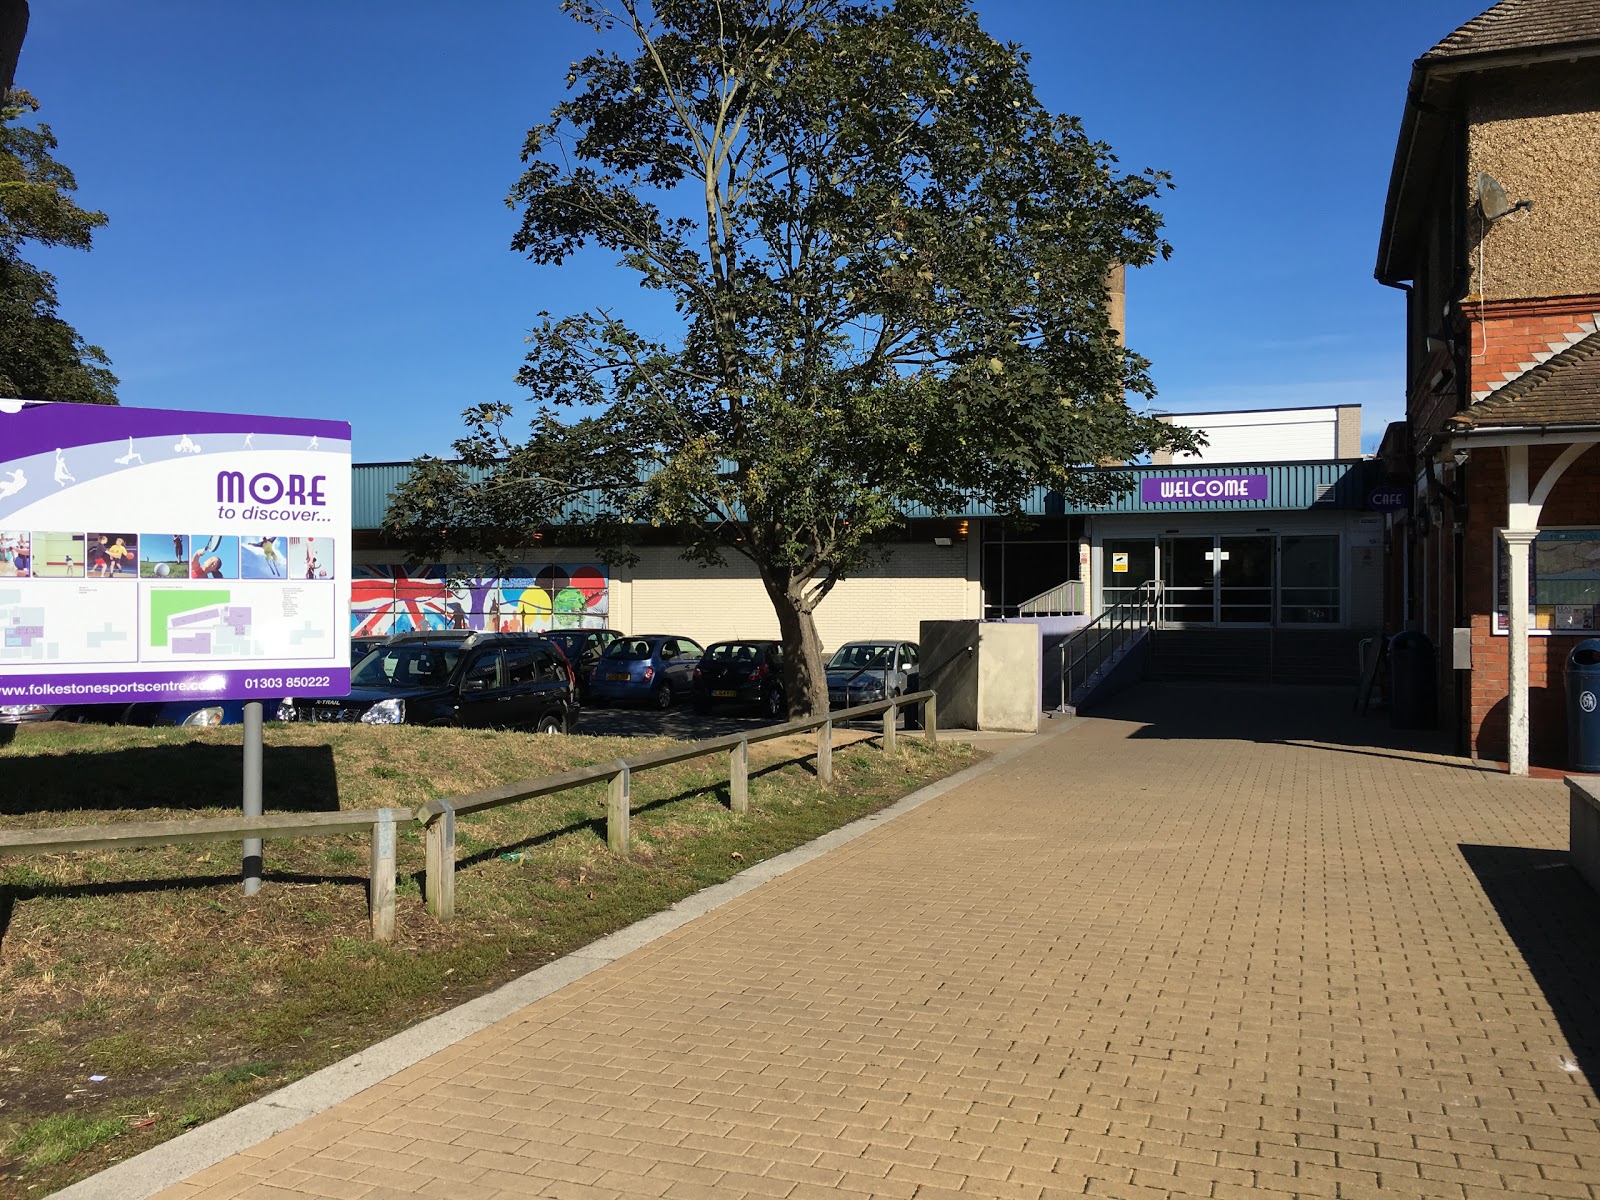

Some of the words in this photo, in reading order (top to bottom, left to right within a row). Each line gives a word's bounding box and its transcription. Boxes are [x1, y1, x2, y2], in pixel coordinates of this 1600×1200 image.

[217, 471, 326, 506] MORE
[1160, 479, 1249, 498] WELCOME
[1372, 493, 1402, 505] CAFE
[218, 506, 236, 519] to
[242, 506, 331, 522] discover...
[0, 674, 227, 697] ww.folkestonesportscentre.co
[244, 678, 282, 689] 01303
[285, 676, 330, 688] 850222
